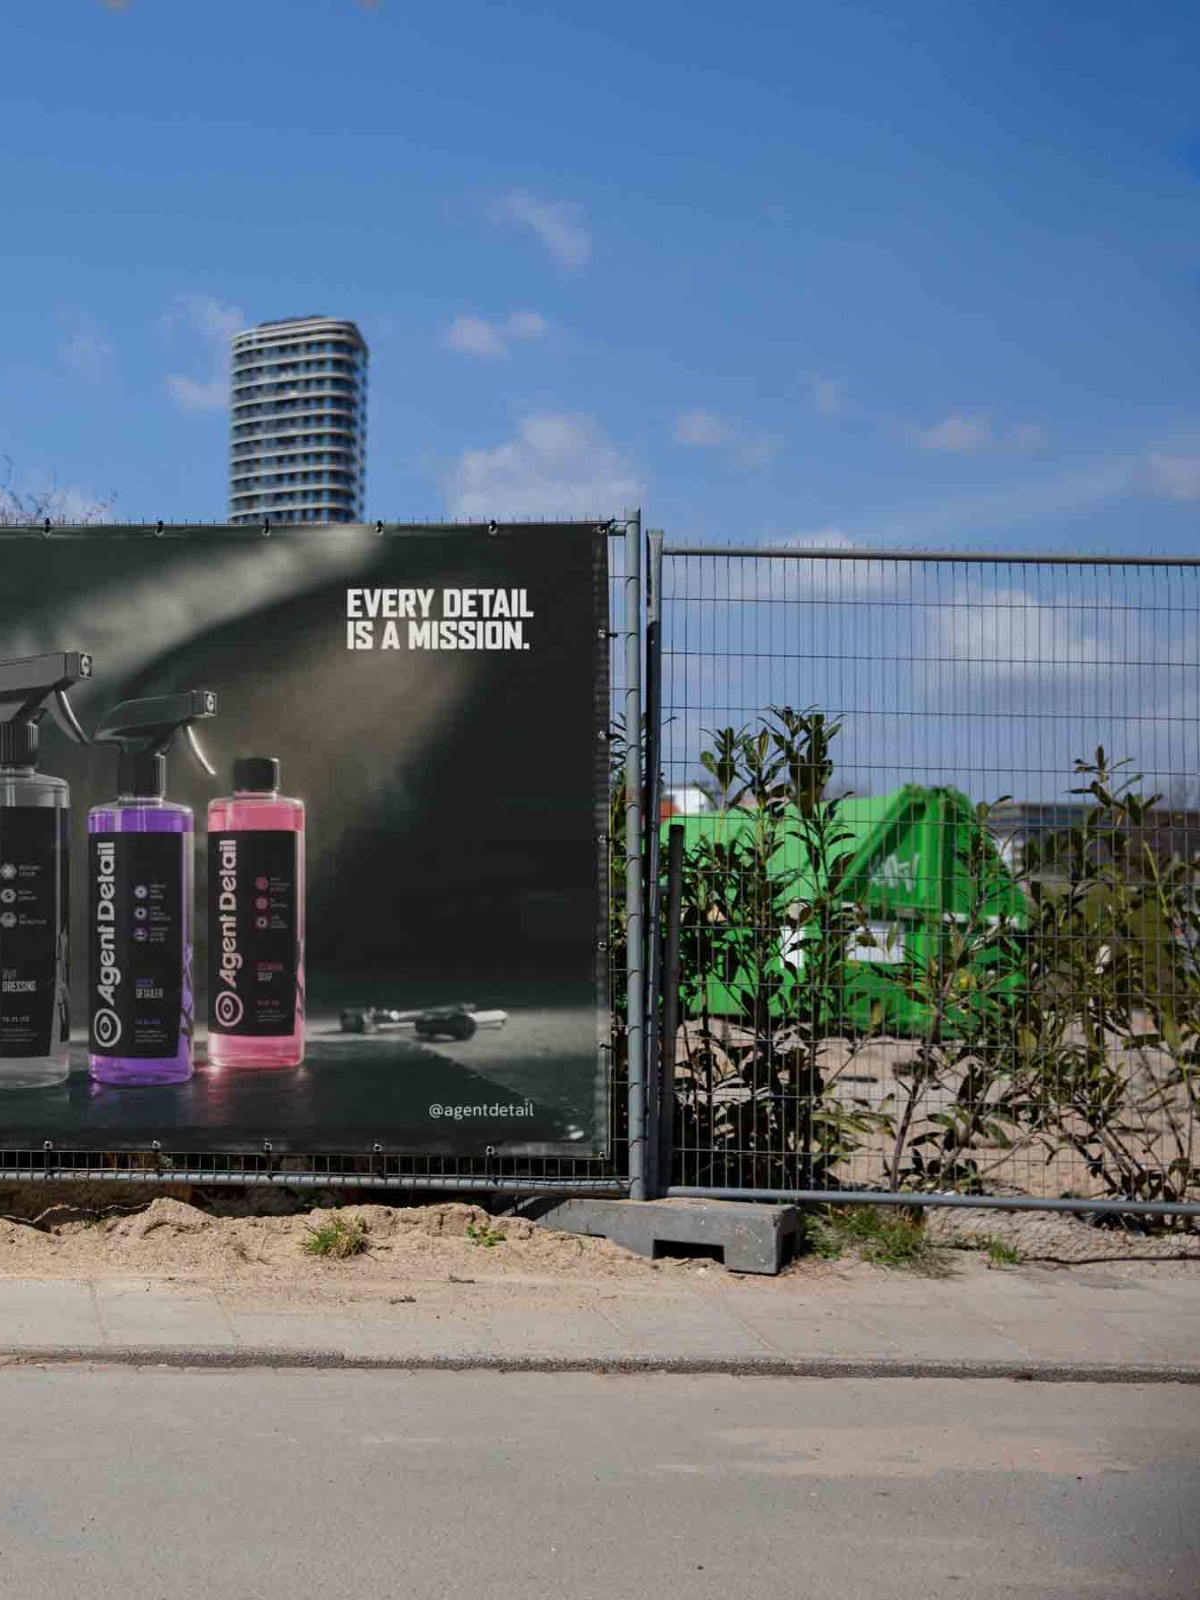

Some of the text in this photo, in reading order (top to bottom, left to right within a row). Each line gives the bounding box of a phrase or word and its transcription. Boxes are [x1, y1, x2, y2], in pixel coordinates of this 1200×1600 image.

[347, 588, 534, 618] EVERY DETAIL
[347, 621, 530, 650] IS A MISSION.
[97, 841, 122, 1006] Agent Detail
[218, 839, 243, 989] Agent Detail
[2, 981, 37, 992] DRESSING
[429, 1102, 534, 1120] @agentdetail
